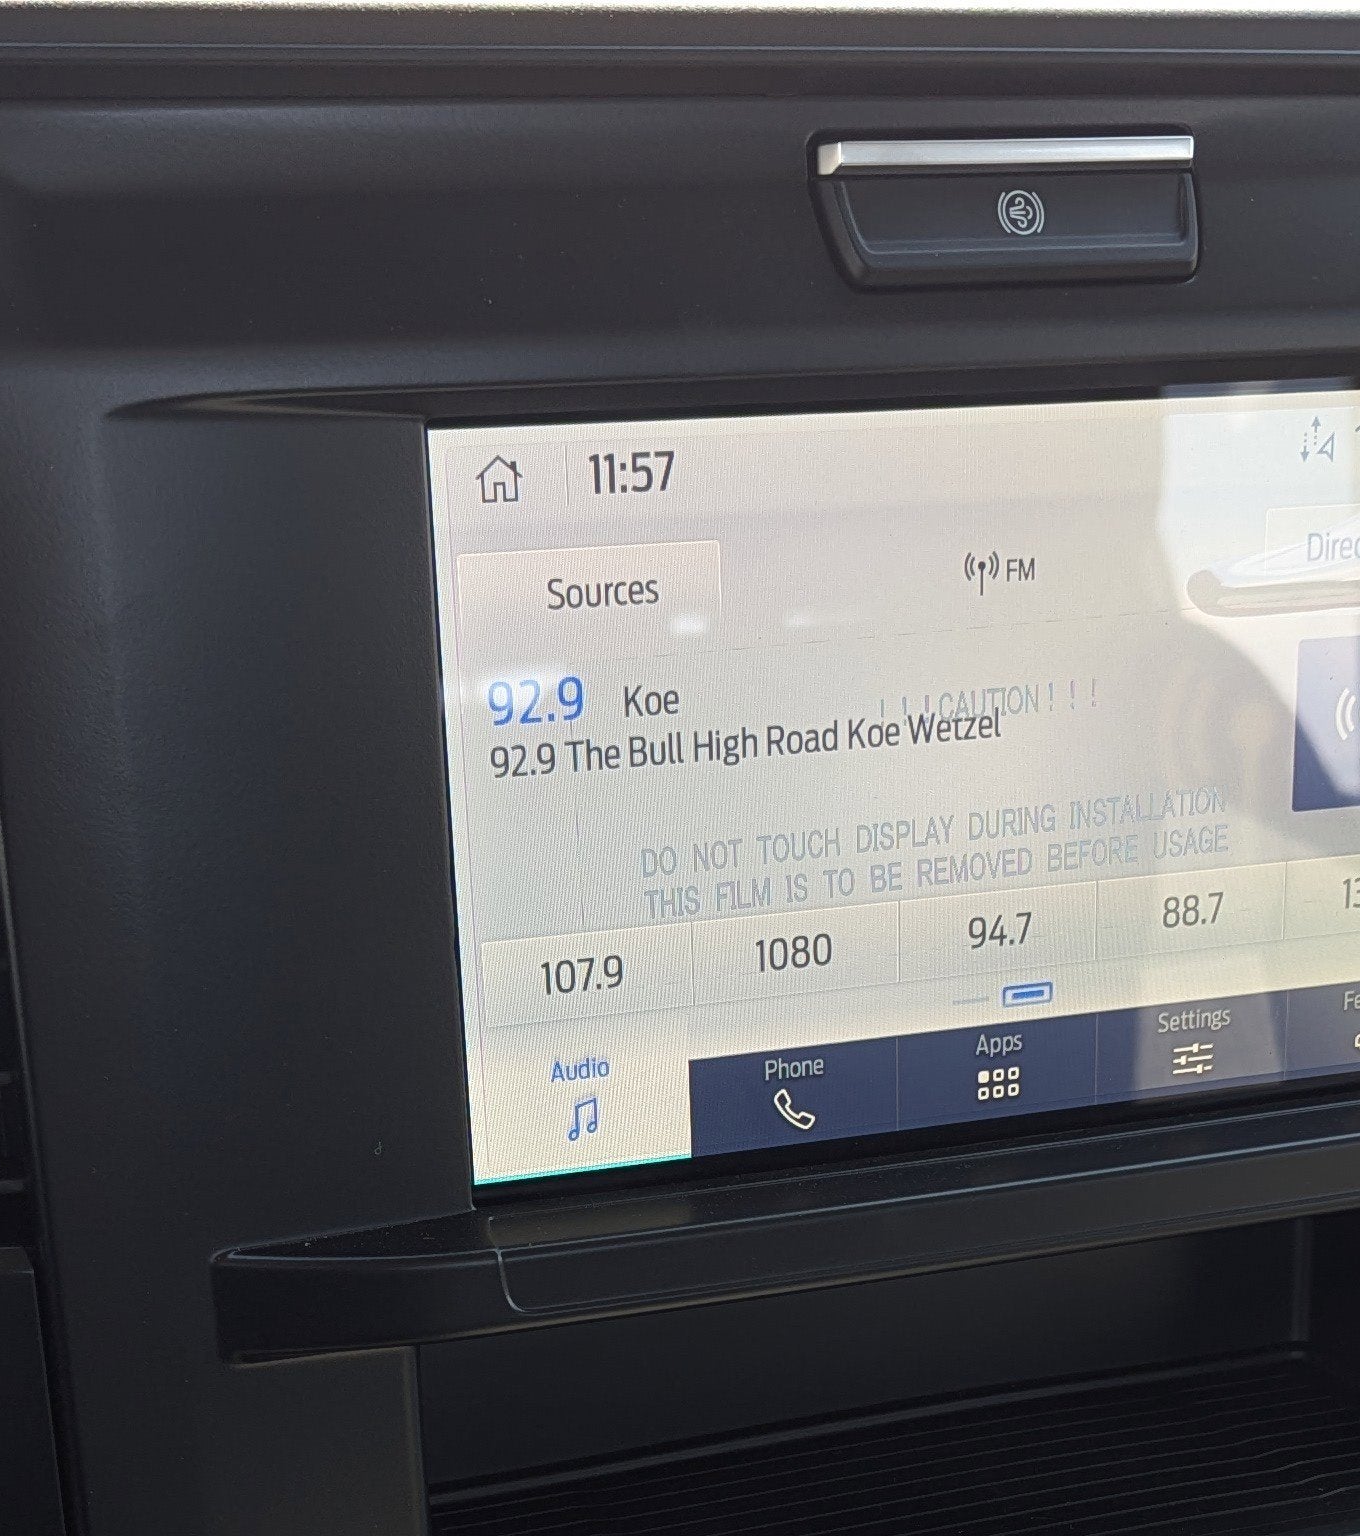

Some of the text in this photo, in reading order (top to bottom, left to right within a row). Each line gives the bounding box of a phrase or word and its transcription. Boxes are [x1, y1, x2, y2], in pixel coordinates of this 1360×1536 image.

[589, 450, 675, 494] 11:57
[1006, 559, 1036, 582] FM
[547, 577, 659, 610] Sources
[487, 676, 680, 726] 92.9 Koe
[490, 707, 1002, 778] 92.9 The Bull High Road Koe Wetzel
[641, 786, 1227, 878] DO NOT TOUCH DISPLAY DURING INSTALLATION
[644, 824, 1228, 919] THIS FILM IS TO BE REMOVED BEFORE USAGE
[1162, 892, 1224, 929] 88.7
[968, 912, 1032, 949] 94.7
[755, 933, 832, 973] 1080
[540, 955, 624, 996] 107.9
[1157, 1005, 1231, 1034] Settings
[976, 1033, 1022, 1058] Apps
[550, 1057, 610, 1083] Audio
[764, 1056, 824, 1082] Phone
